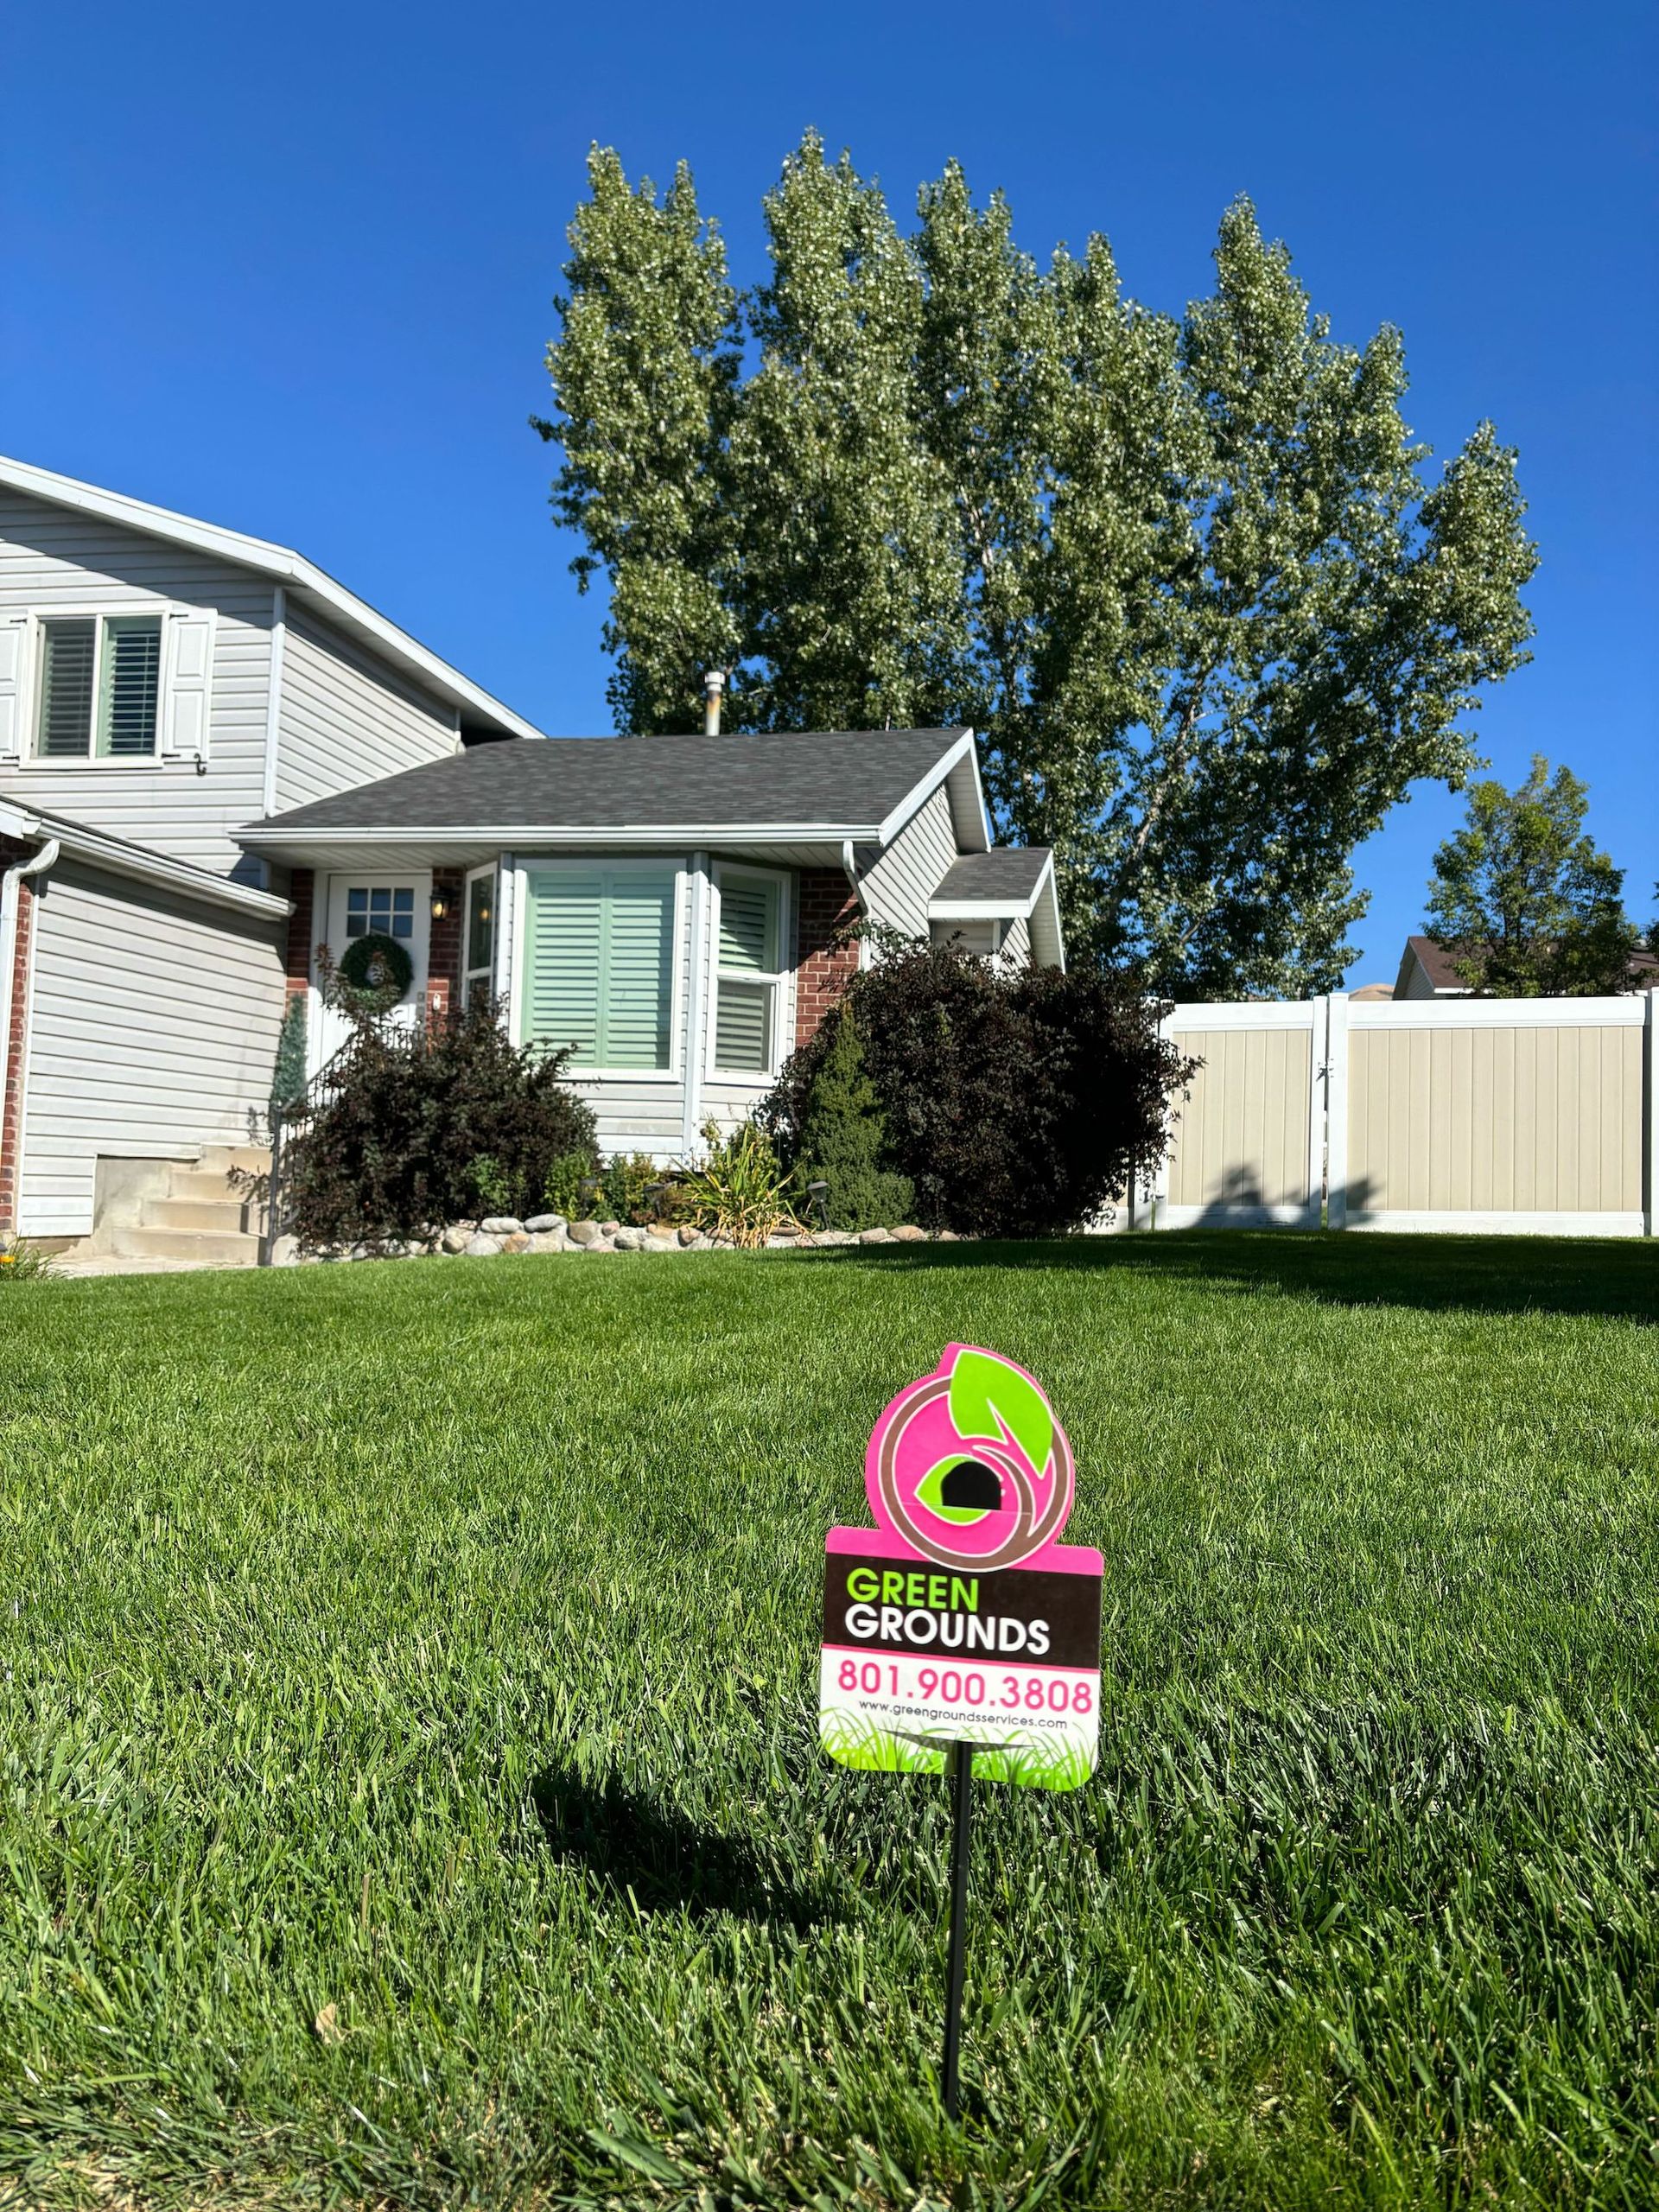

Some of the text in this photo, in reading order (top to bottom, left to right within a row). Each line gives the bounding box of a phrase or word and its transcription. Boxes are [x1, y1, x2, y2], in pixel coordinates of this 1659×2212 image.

[847, 1567, 979, 1612] GREEN
[844, 1603, 1051, 1655] GROUNDS
[838, 1660, 1093, 1714] 801.900.3808
[859, 1700, 1068, 1730] www.greengroundsservices.com
